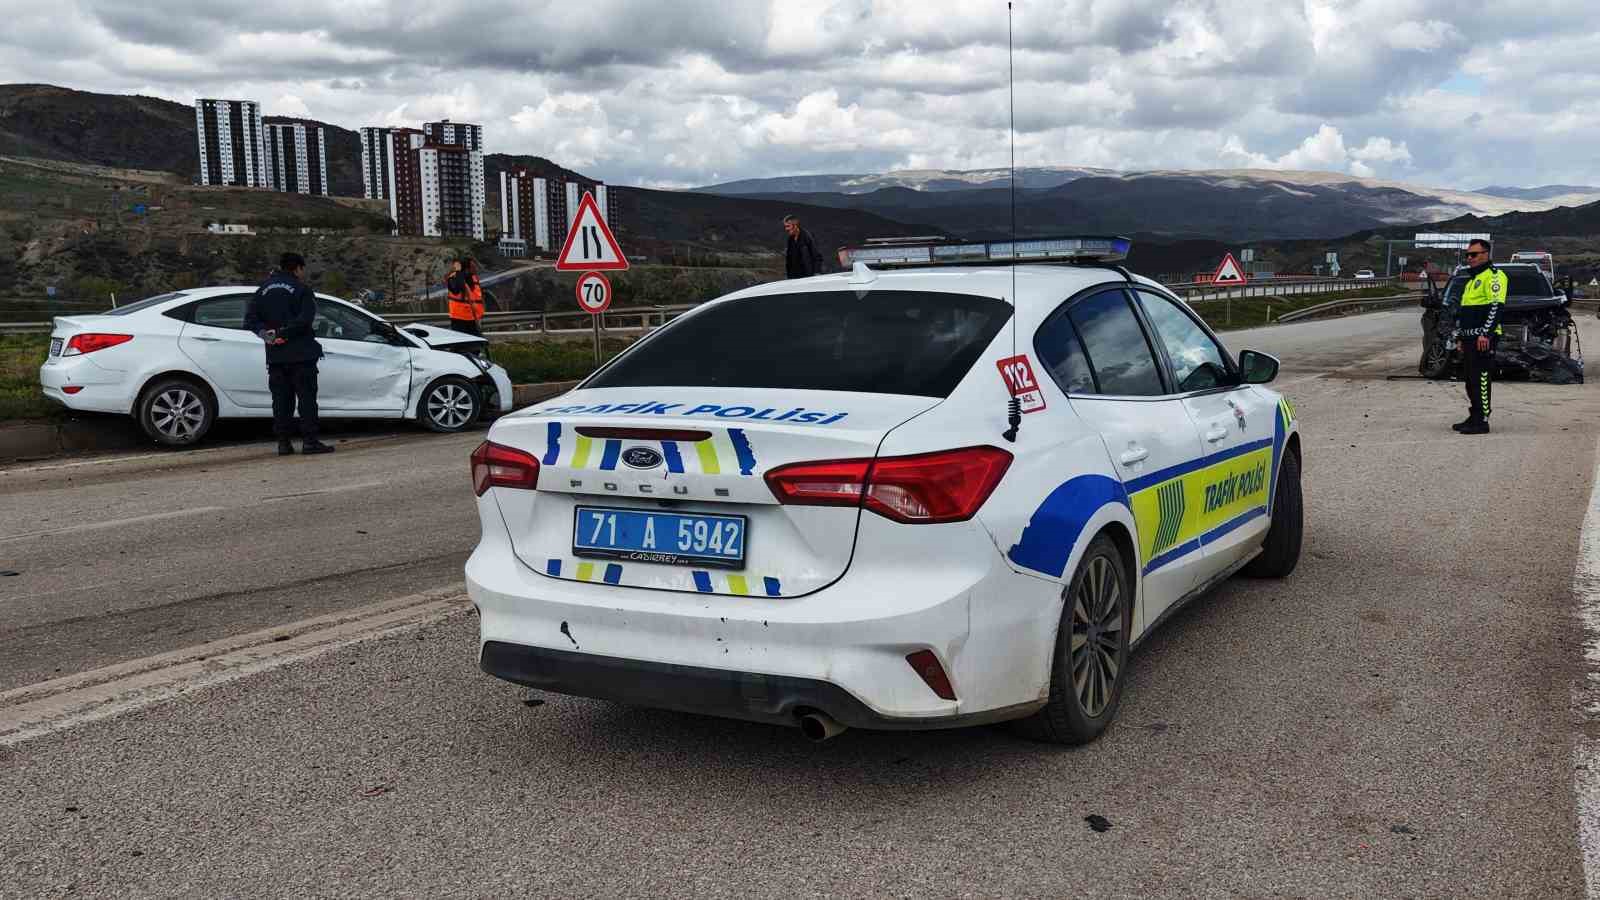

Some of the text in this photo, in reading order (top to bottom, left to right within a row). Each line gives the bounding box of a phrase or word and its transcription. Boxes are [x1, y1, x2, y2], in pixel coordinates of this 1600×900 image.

[583, 283, 604, 303] 70
[1003, 361, 1034, 391] 112
[682, 403, 849, 425] POLİSİ
[570, 479, 730, 497] FOCUS
[590, 512, 739, 555] 71 A 5942
